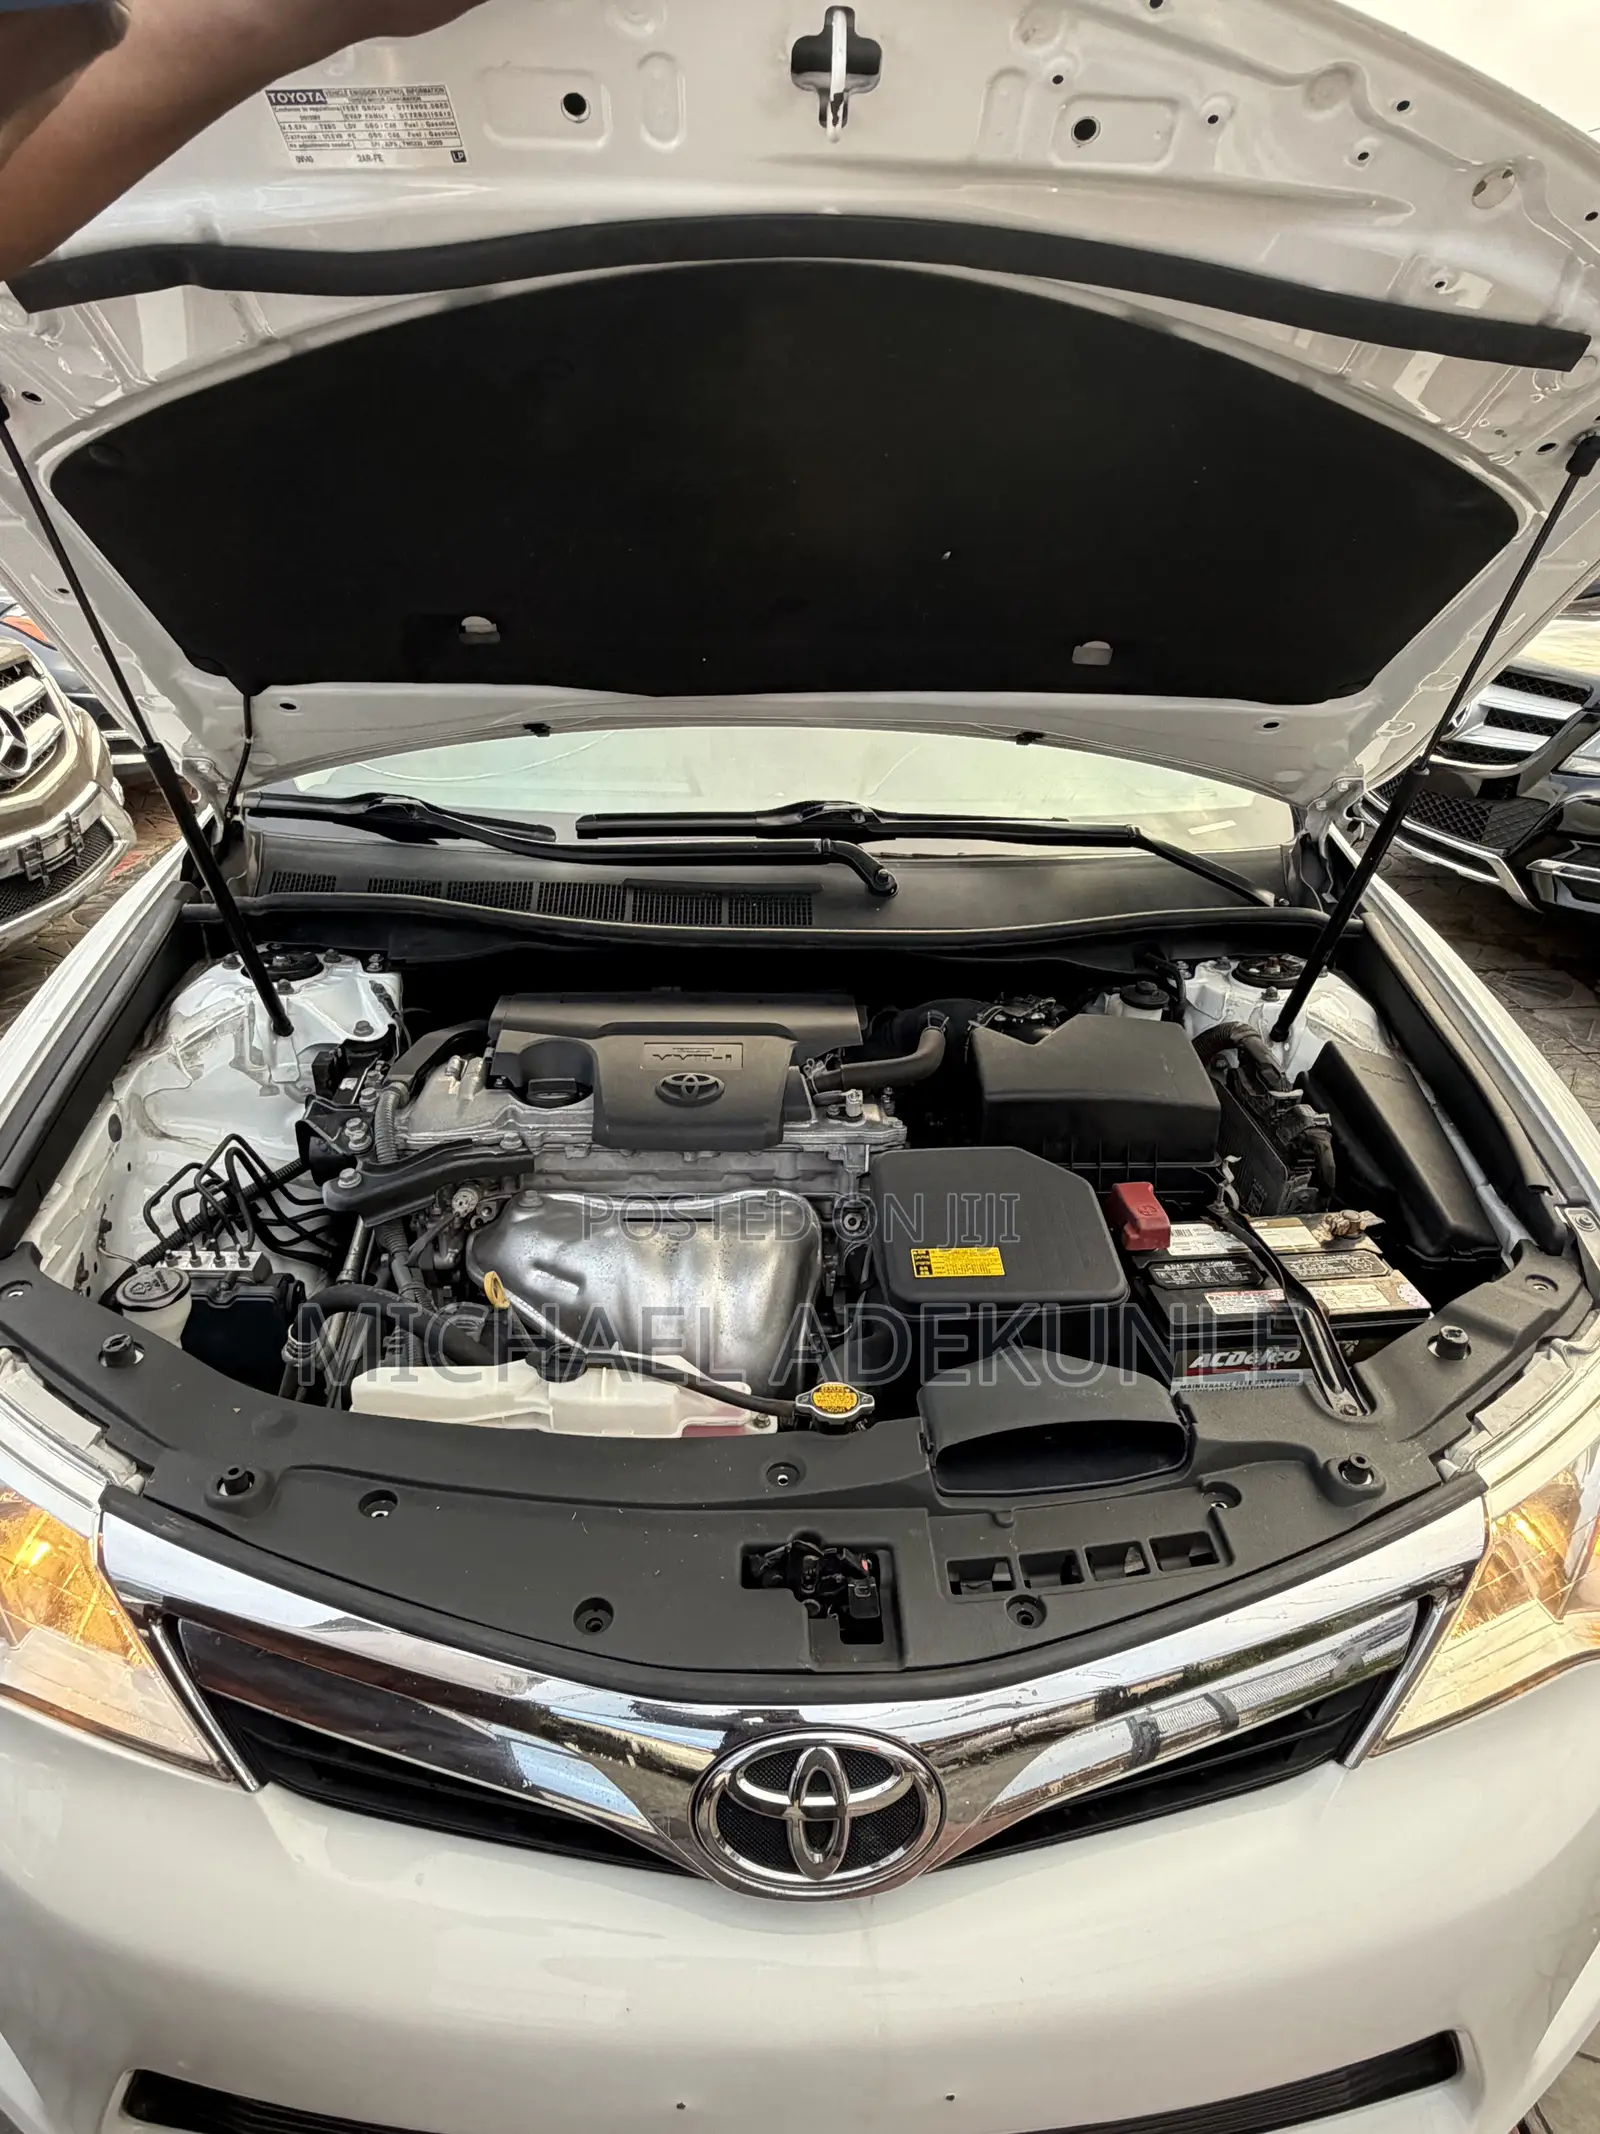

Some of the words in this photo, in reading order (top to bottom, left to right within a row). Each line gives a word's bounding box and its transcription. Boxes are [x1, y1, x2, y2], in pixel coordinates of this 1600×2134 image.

[406, 87, 445, 95] INFORMATION
[268, 91, 325, 104] TOYOTA
[452, 152, 465, 162] LP
[1188, 1347, 1301, 1369] ACDelco
[1180, 1381, 1233, 1390] MAINTENANCE
